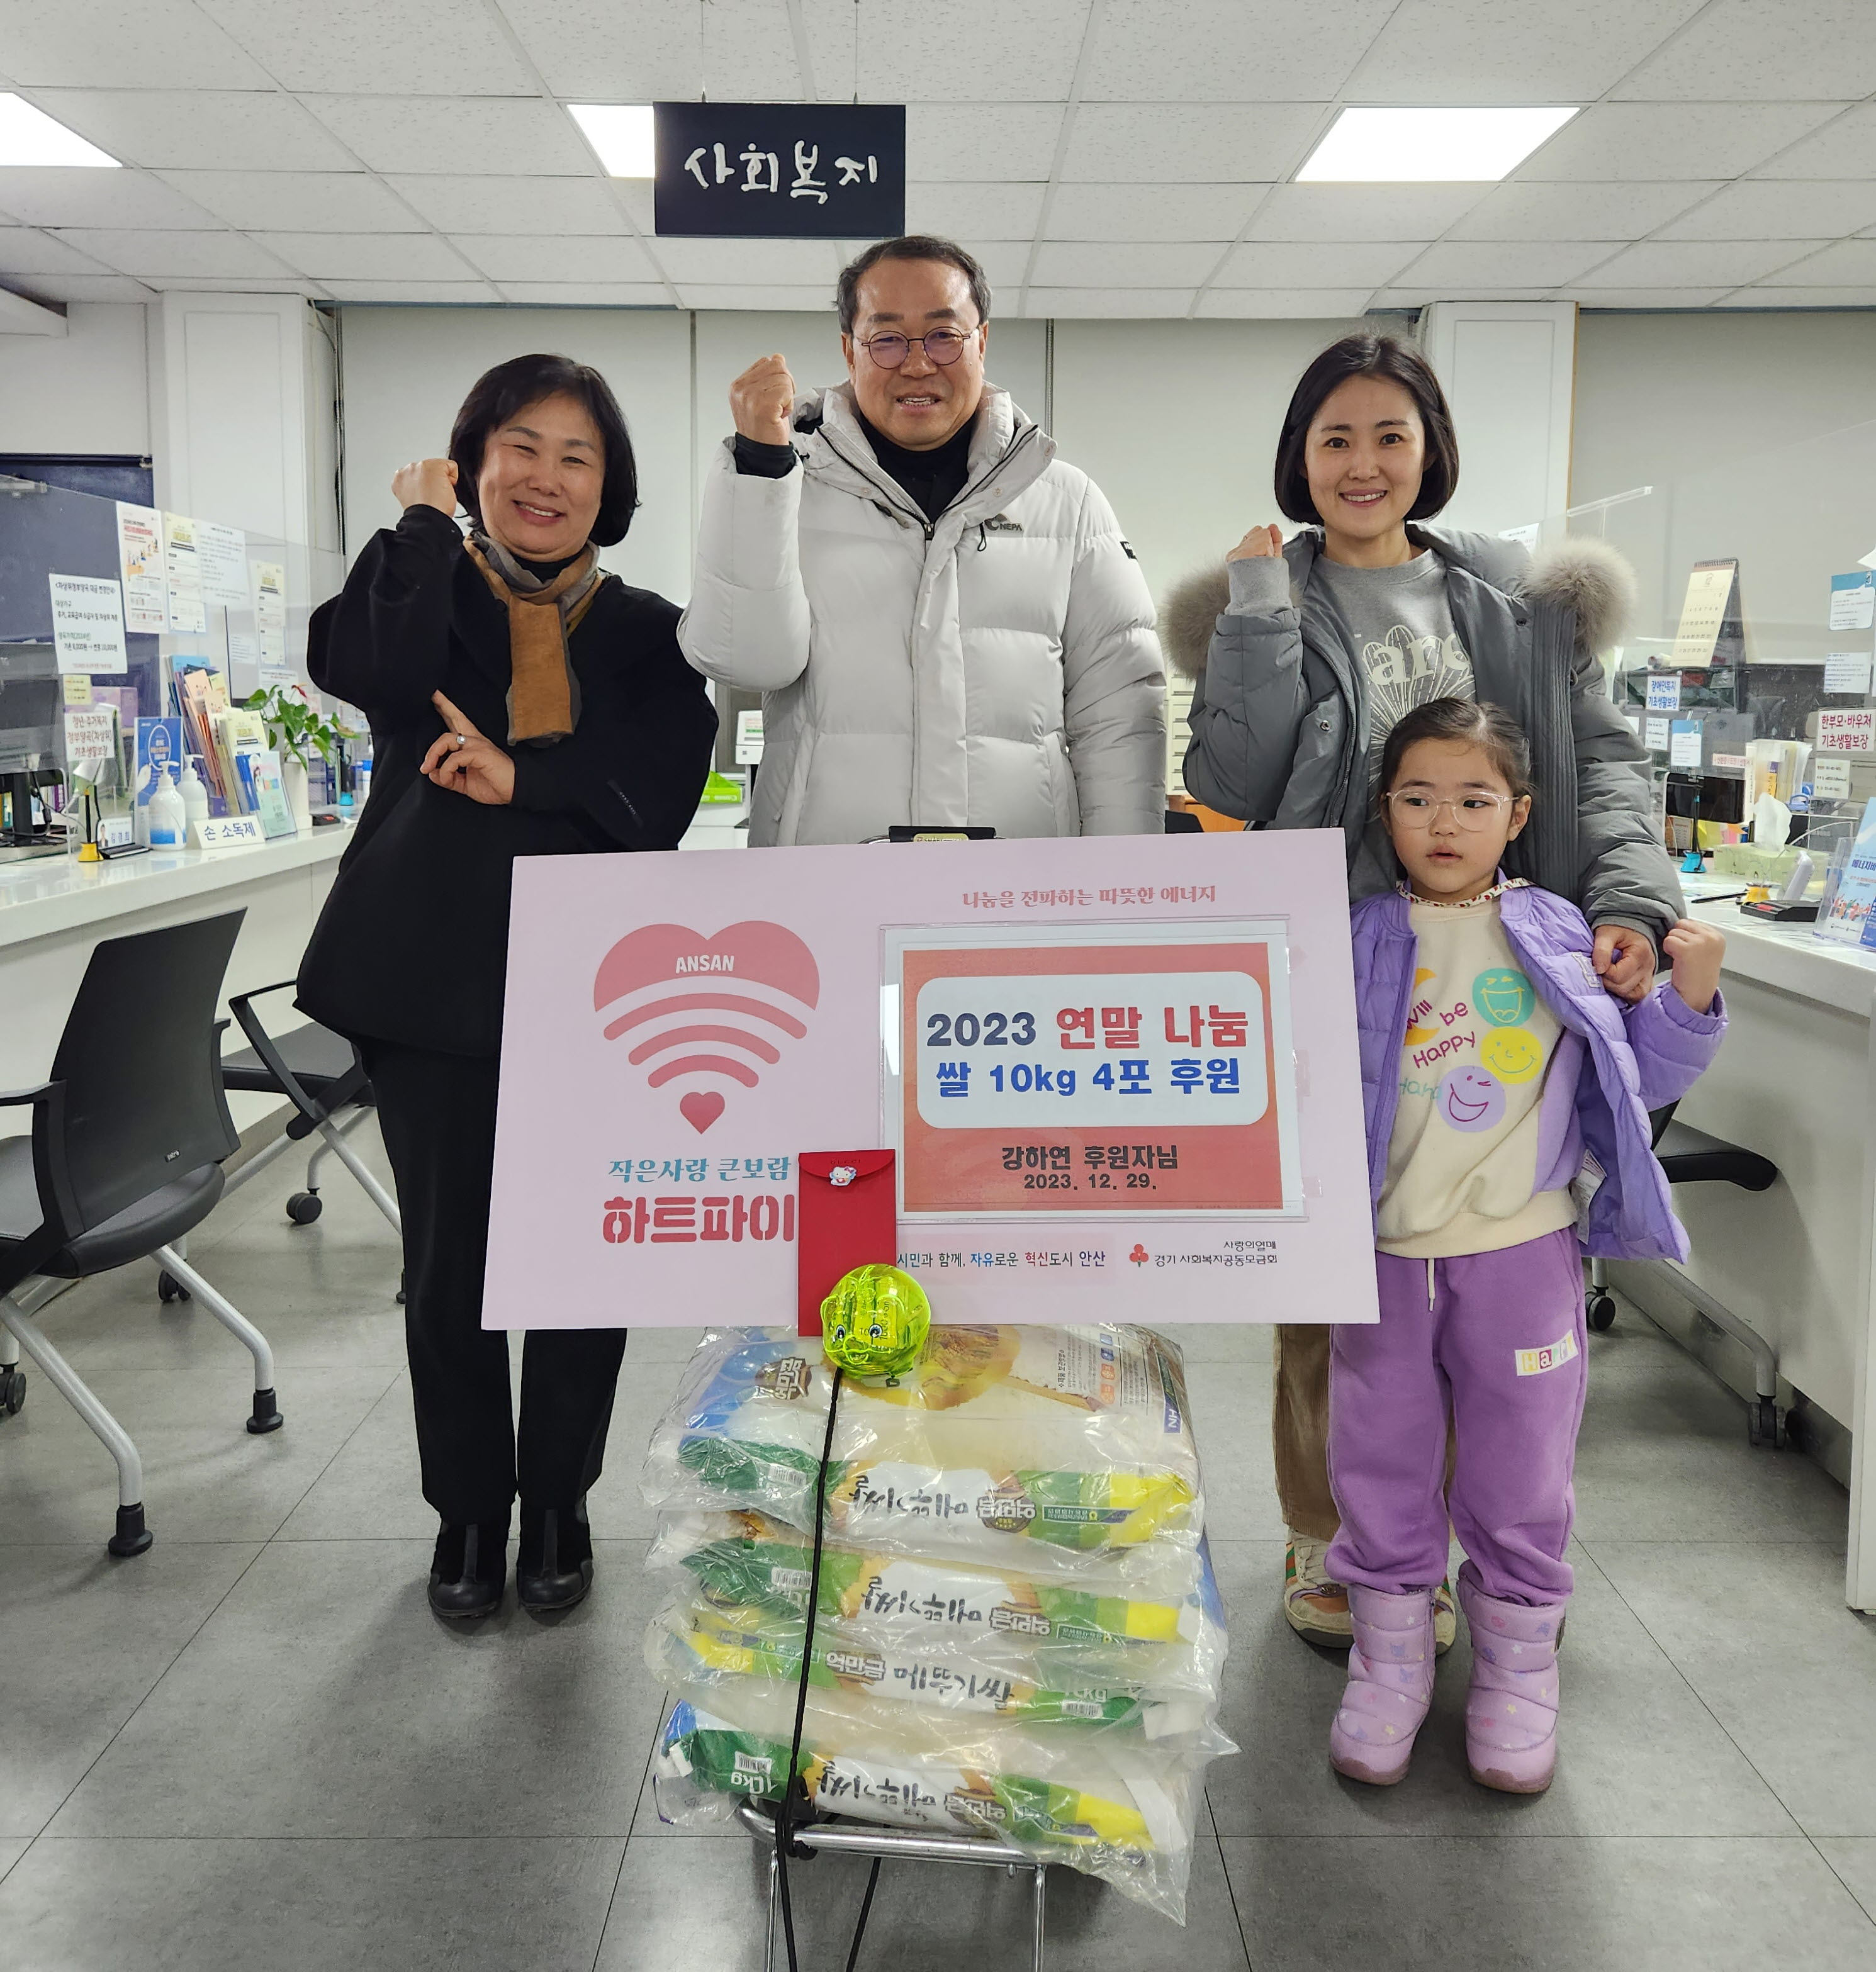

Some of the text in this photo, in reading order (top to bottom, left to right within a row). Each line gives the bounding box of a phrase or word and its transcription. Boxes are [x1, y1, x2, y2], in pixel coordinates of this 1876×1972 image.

[684, 140, 878, 204] 사회복지
[999, 522, 1023, 532] NEPA
[1651, 680, 1677, 692] 장애인복지
[1648, 696, 1678, 709] 기초생활보장
[74, 746, 108, 757] 기초생활보장
[1821, 733, 1868, 750] 기초생활보장
[204, 821, 256, 841] 손 소독제
[962, 885, 1216, 909] 나눔을 전파하는 따뜻한 에너지
[675, 954, 735, 973] ANSAN
[1439, 1001, 1469, 1026] be
[926, 1004, 1249, 1050] 2023 연말 나눔
[1413, 1031, 1476, 1069] Happy
[936, 1058, 1241, 1098] 쌀 10kg 4포 후원
[608, 1155, 792, 1183] 작은사랑 큰보람
[1001, 1144, 1178, 1170] 강하연 후원자님
[1024, 1173, 1157, 1190] 2023. 12. 29.
[603, 1194, 795, 1244] 하트파이
[1223, 1240, 1277, 1250] 사랑의열매
[897, 1250, 1106, 1269] 시민과 함께, 자유로운 혁신도시 안산
[1154, 1252, 1278, 1267] 경기 사회복지공동모금회
[774, 1358, 803, 1401] 억만금
[1167, 1408, 1180, 1428] NH
[848, 1474, 1036, 1520] 억만금 메뚜기쌀
[861, 1576, 1052, 1637] 억만금 메뚜기쌀
[826, 1651, 1015, 1710] 억만금 메뚜기쌀
[731, 1771, 778, 1795] 10kg
[816, 1760, 1007, 1820] 억만금 메뚜기쌀
